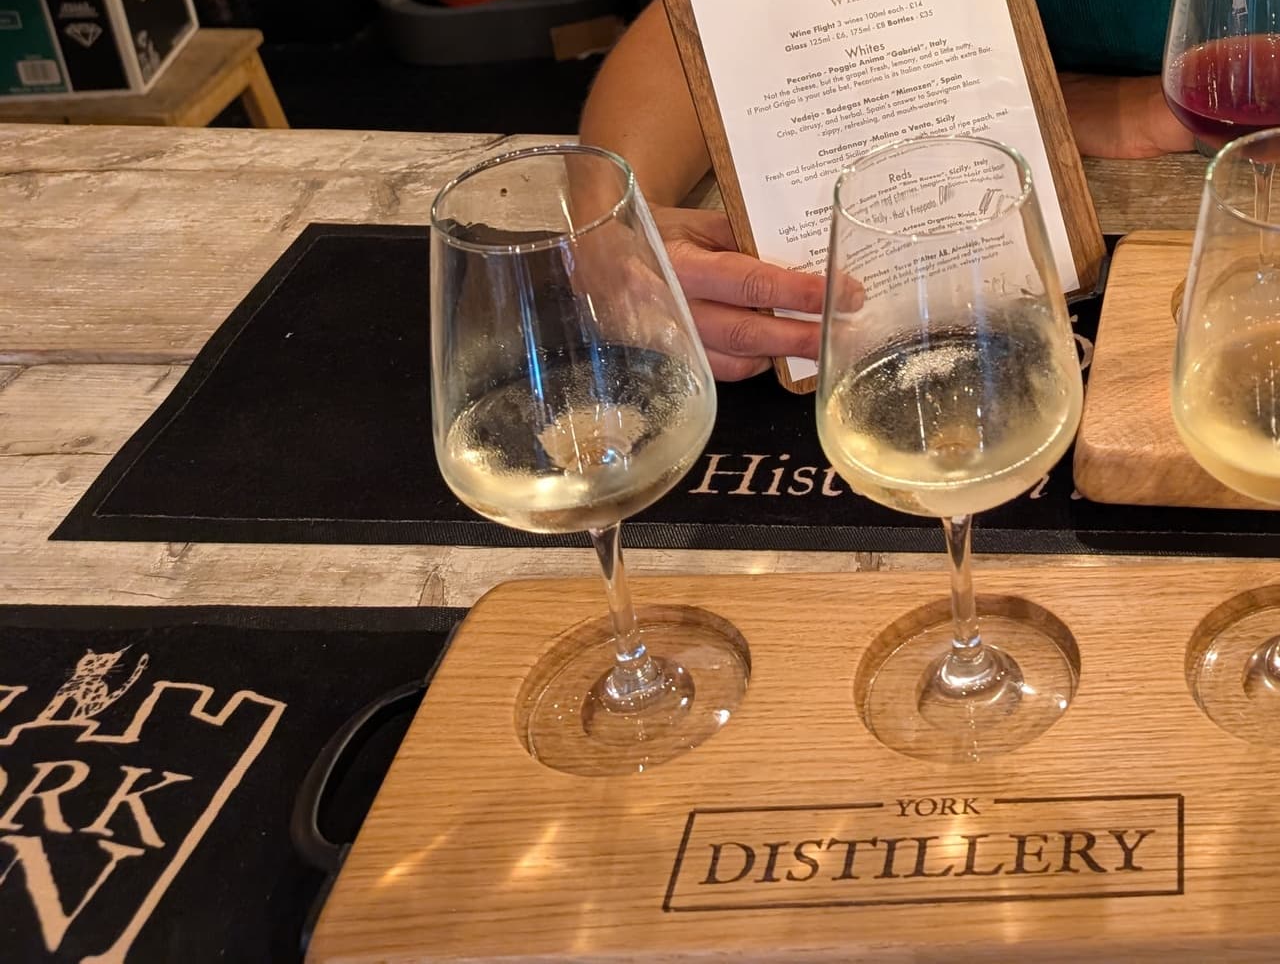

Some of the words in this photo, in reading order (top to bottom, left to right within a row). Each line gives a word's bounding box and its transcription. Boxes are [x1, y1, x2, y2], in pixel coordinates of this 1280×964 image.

[784, 42, 808, 52] Glass
[808, 34, 830, 46] 125ml
[886, 16, 914, 26] Bottles
[788, 30, 812, 38] Wine
[812, 22, 836, 34] Flight
[844, 16, 864, 26] wines
[864, 8, 886, 20] 100ml
[888, 4, 904, 14] each
[786, 72, 822, 84] Pecorino
[828, 62, 856, 74] Poggio
[928, 38, 948, 48] Italy
[844, 44, 886, 58] Whites
[754, 104, 772, 114] Pinot
[772, 98, 796, 108] Grigio
[804, 92, 820, 102] your
[822, 86, 836, 96] safe
[838, 84, 852, 92] bet,
[854, 76, 884, 88] Pecorino
[900, 66, 922, 76] Italian
[922, 60, 944, 70] cousin
[944, 54, 958, 62] with
[960, 50, 978, 60] extra
[764, 92, 778, 100] Not
[792, 84, 818, 94] cheese,
[818, 78, 832, 86] but
[832, 76, 844, 84] the
[870, 62, 890, 74] Fresh,
[890, 56, 918, 68] lemony,
[918, 50, 932, 60] and
[940, 46, 954, 54] little
[776, 128, 798, 138] Crisp,
[798, 122, 824, 132] citrusy,
[824, 116, 838, 126] and
[866, 102, 892, 114] Spain's
[892, 96, 916, 106] answer
[924, 84, 962, 98] Sauvignon
[826, 102, 862, 116] Bodegas
[940, 74, 962, 84] Spain
[818, 140, 868, 156] Chardonnay
[936, 114, 956, 124] Sicily
[822, 126, 842, 136] zippy,
[844, 116, 880, 130] refreshing,
[882, 110, 896, 120] and
[764, 172, 784, 182] Fresh
[786, 166, 800, 176] and
[930, 126, 948, 138] notes
[958, 120, 970, 128] ripe
[972, 112, 994, 126] peach,
[804, 172, 818, 182] and
[888, 168, 912, 184] Reds
[778, 224, 798, 236] Light,
[798, 220, 818, 230] juicy,
[804, 204, 836, 218] Frappa
[800, 228, 822, 240] taking
[688, 452, 862, 498] Hist
[0, 760, 193, 849] RK
[895, 797, 981, 817] YORK
[698, 829, 1156, 886] DISTILLERY
